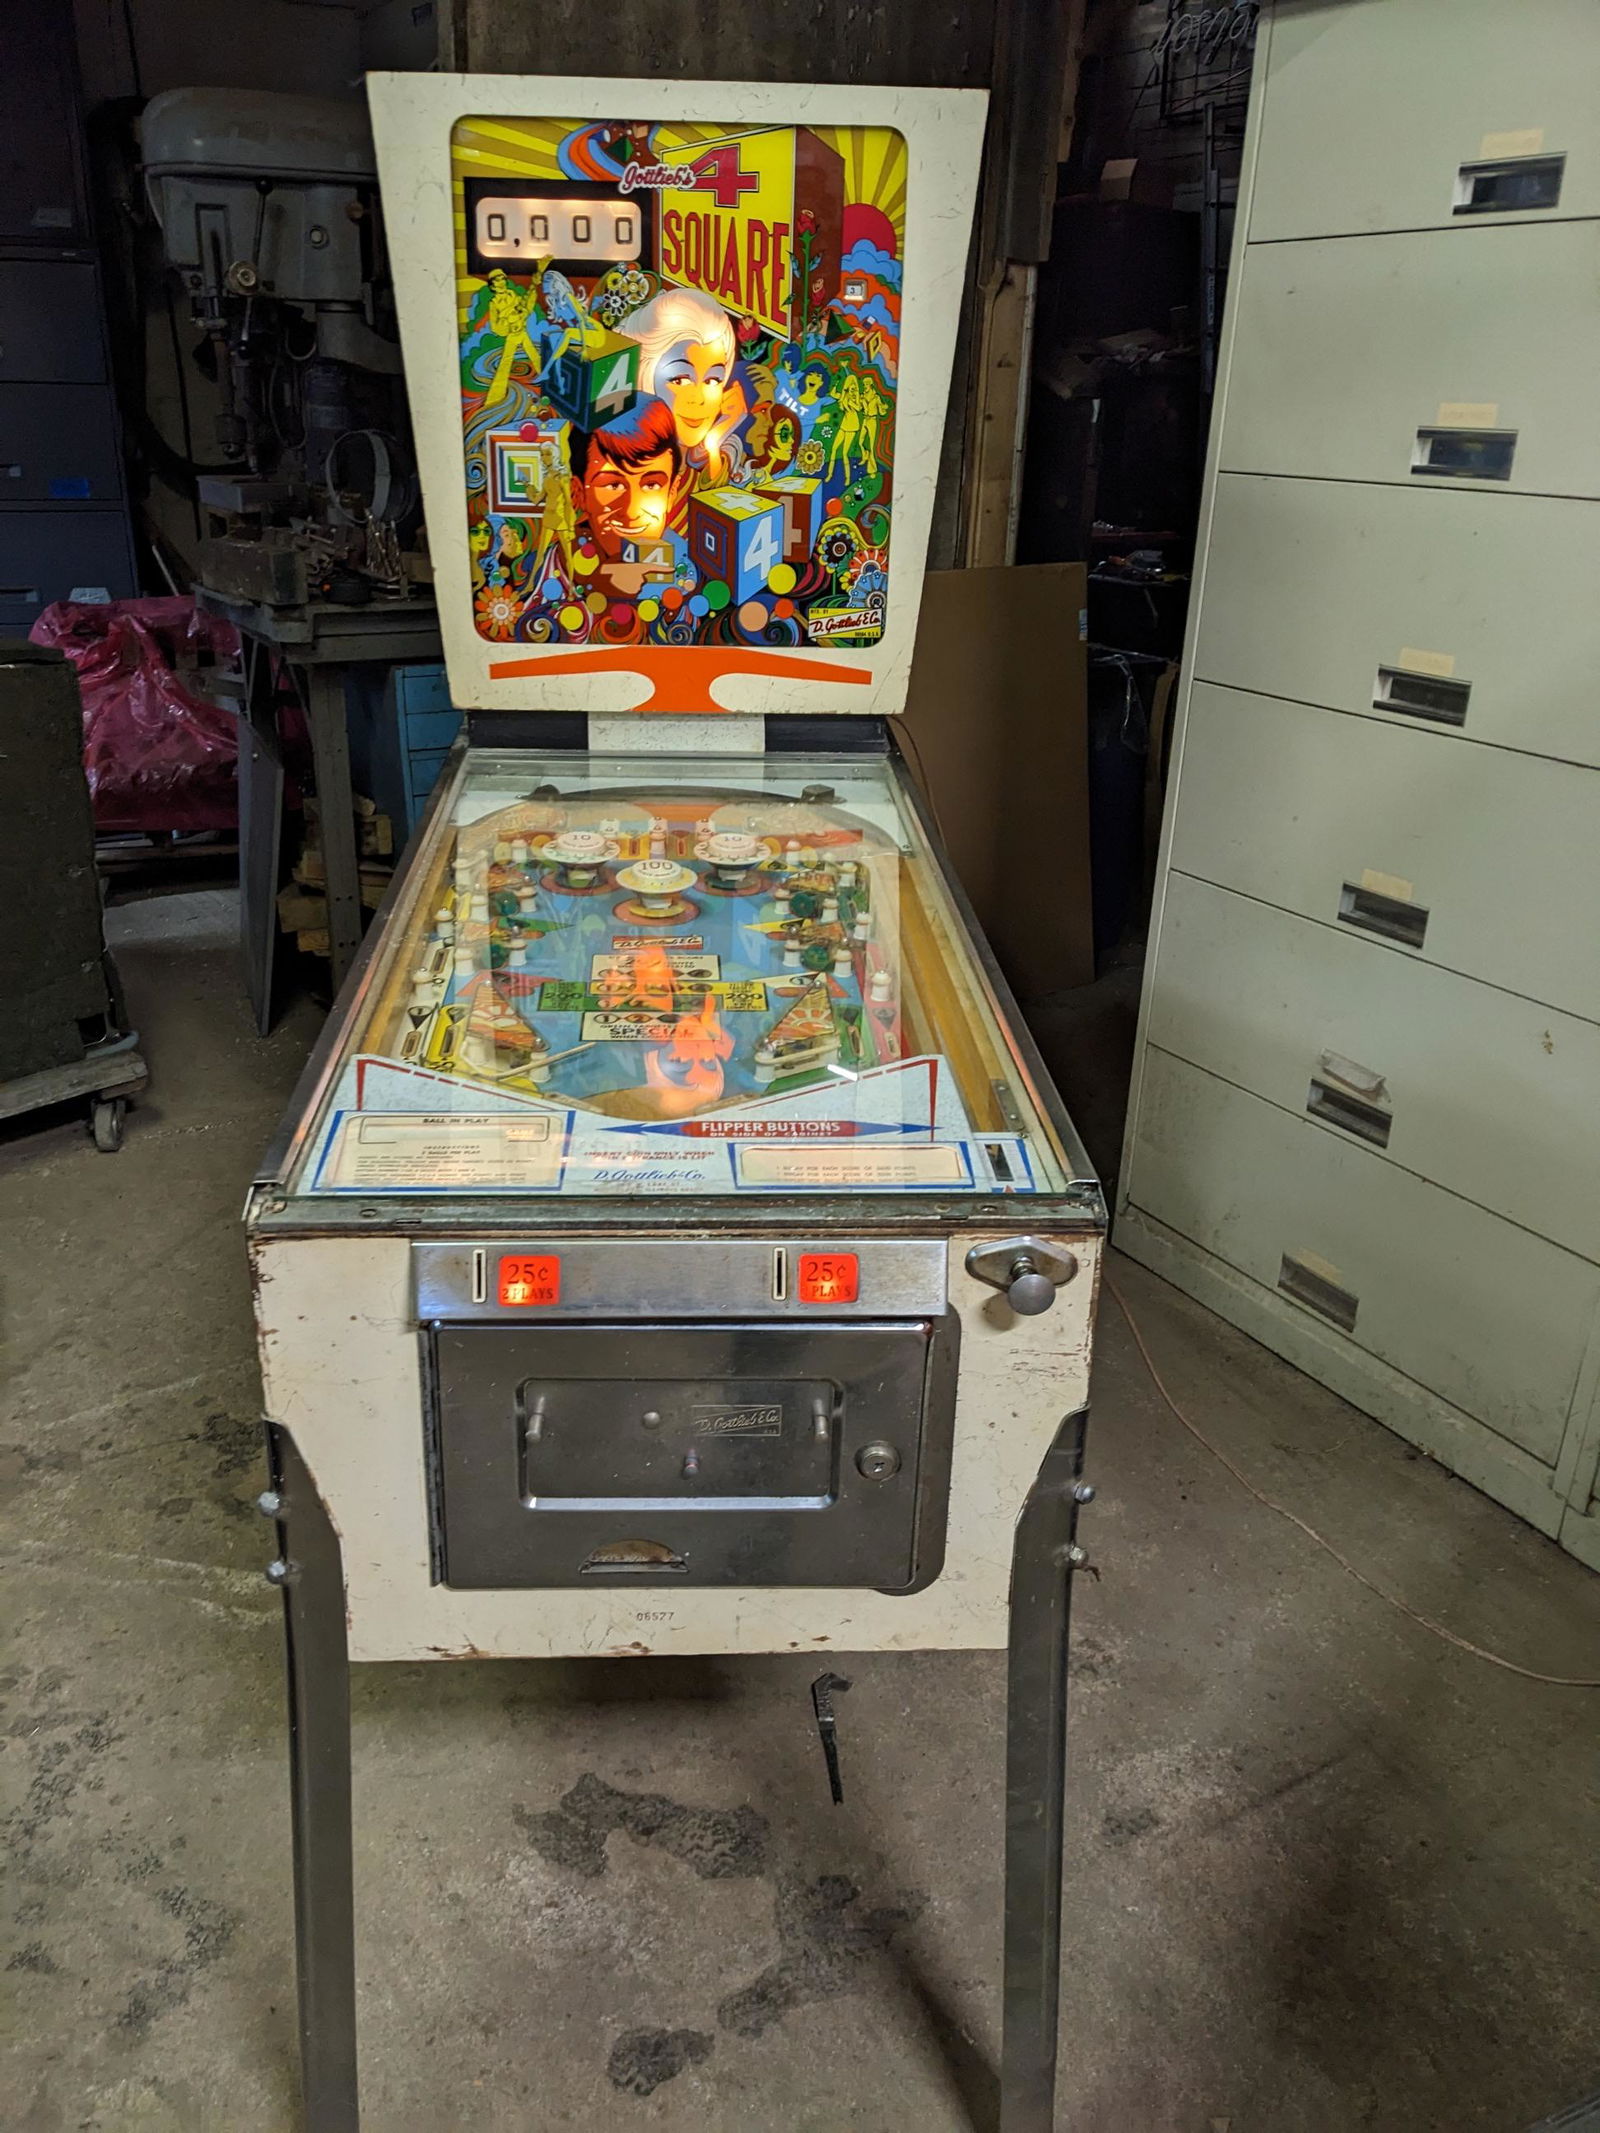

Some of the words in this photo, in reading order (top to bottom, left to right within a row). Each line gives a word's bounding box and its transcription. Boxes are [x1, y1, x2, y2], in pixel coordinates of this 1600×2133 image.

[620, 164, 696, 192] Gottlieb's
[663, 209, 790, 328] SQUARE
[778, 387, 809, 417] TILT
[744, 515, 779, 581] 4
[825, 612, 862, 632] Gottlieb
[641, 861, 673, 871] 100
[726, 992, 763, 1000] 200
[609, 1028, 694, 1036] SPECIAL
[701, 1121, 764, 1132] FLIPPER
[766, 1121, 841, 1132] BUTTONS
[611, 1169, 677, 1180] Gottlieb
[507, 1263, 549, 1284] 25¢
[806, 1261, 847, 1282] 25¢
[502, 1288, 510, 1300] 2
[512, 1287, 554, 1300] PLAYS
[811, 1284, 853, 1298] PLAYS
[713, 1411, 757, 1431] Gottlieb
